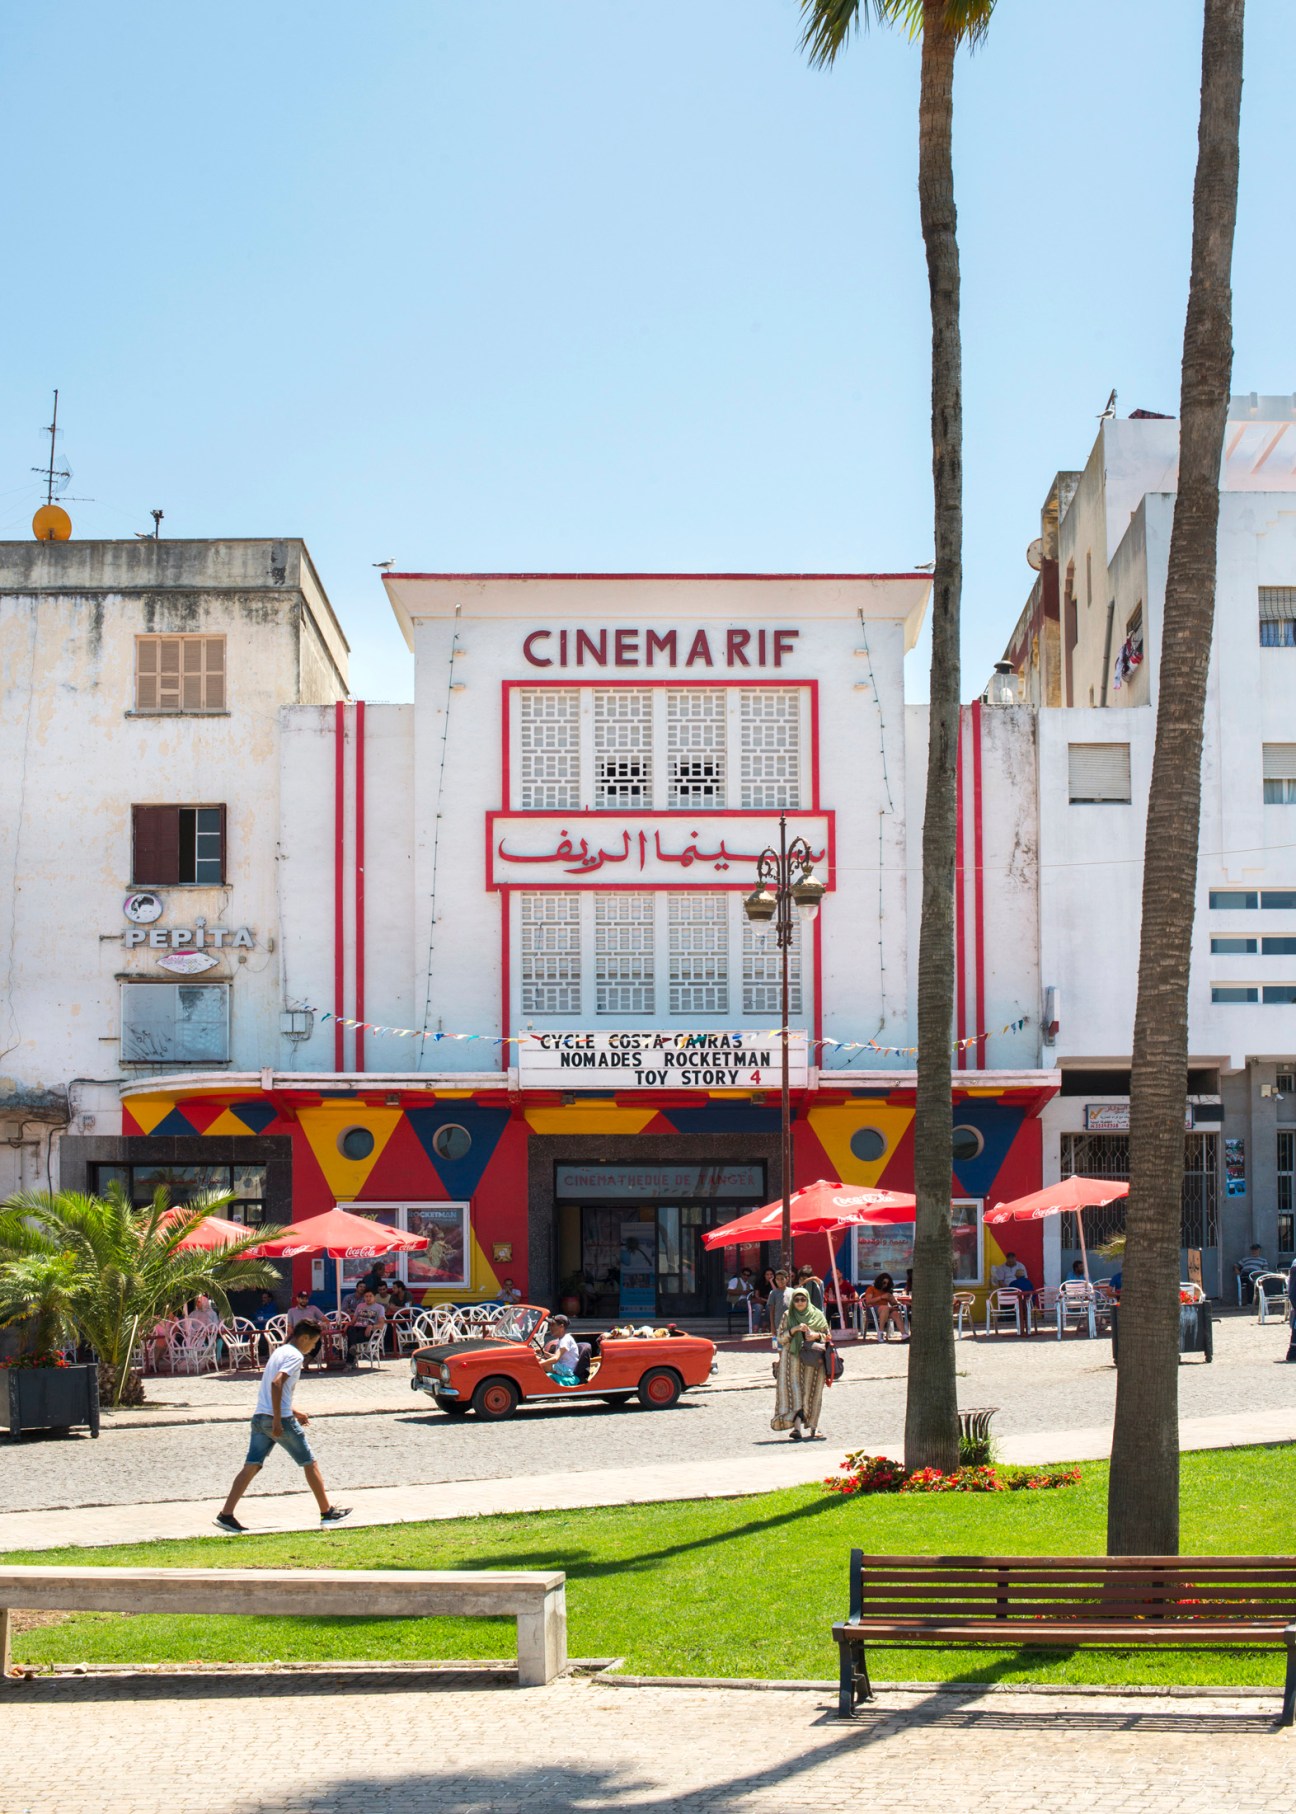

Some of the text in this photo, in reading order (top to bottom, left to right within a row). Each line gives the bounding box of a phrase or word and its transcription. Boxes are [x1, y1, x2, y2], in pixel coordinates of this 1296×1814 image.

[498, 829, 826, 874] سينما الريف
[540, 1034, 595, 1049] CYCLE
[560, 1052, 770, 1067] NOMADES ROCKETMAN
[635, 1069, 761, 1085] TOY STORY 4
[675, 1174, 691, 1185] DE
[699, 1173, 755, 1186] TANGER
